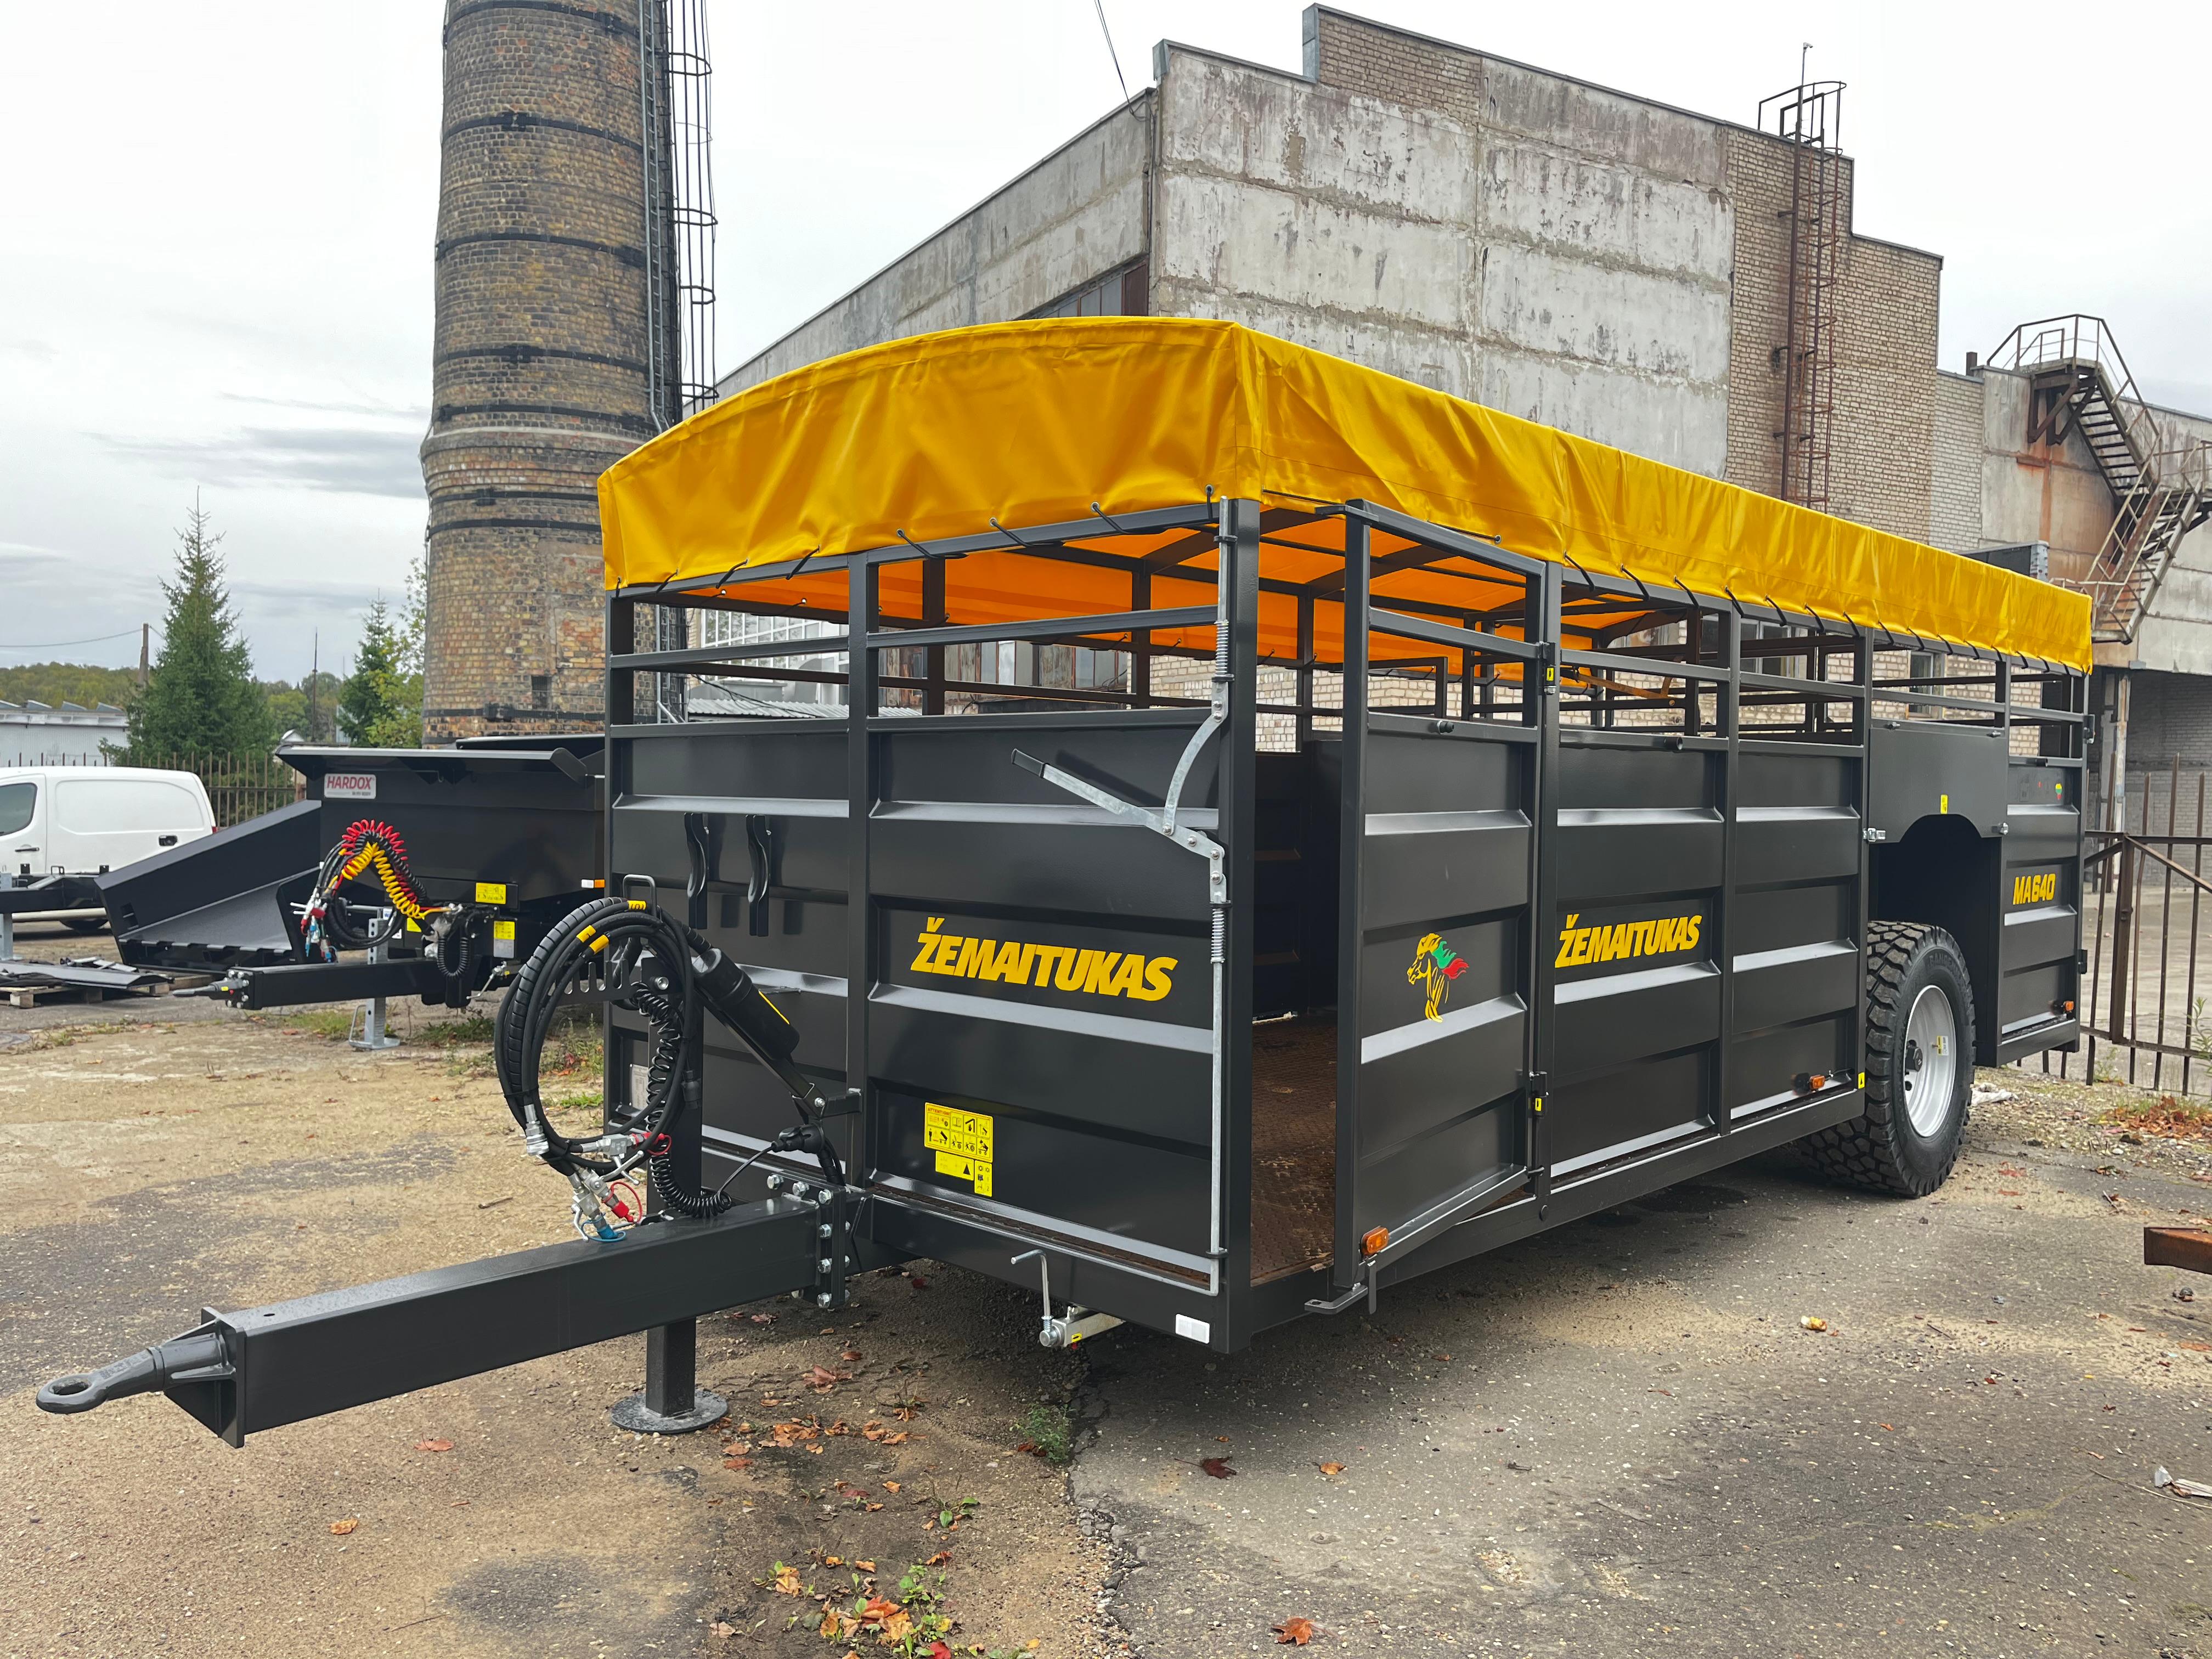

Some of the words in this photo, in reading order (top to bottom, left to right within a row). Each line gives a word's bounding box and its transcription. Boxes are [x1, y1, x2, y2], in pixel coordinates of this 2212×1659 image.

[327, 776, 372, 789] HARDOX
[2012, 873, 2056, 905] MA640
[910, 917, 1178, 1001] ŽEMAITUKAS
[1555, 913, 1702, 968] ŽEMAITUKAS
